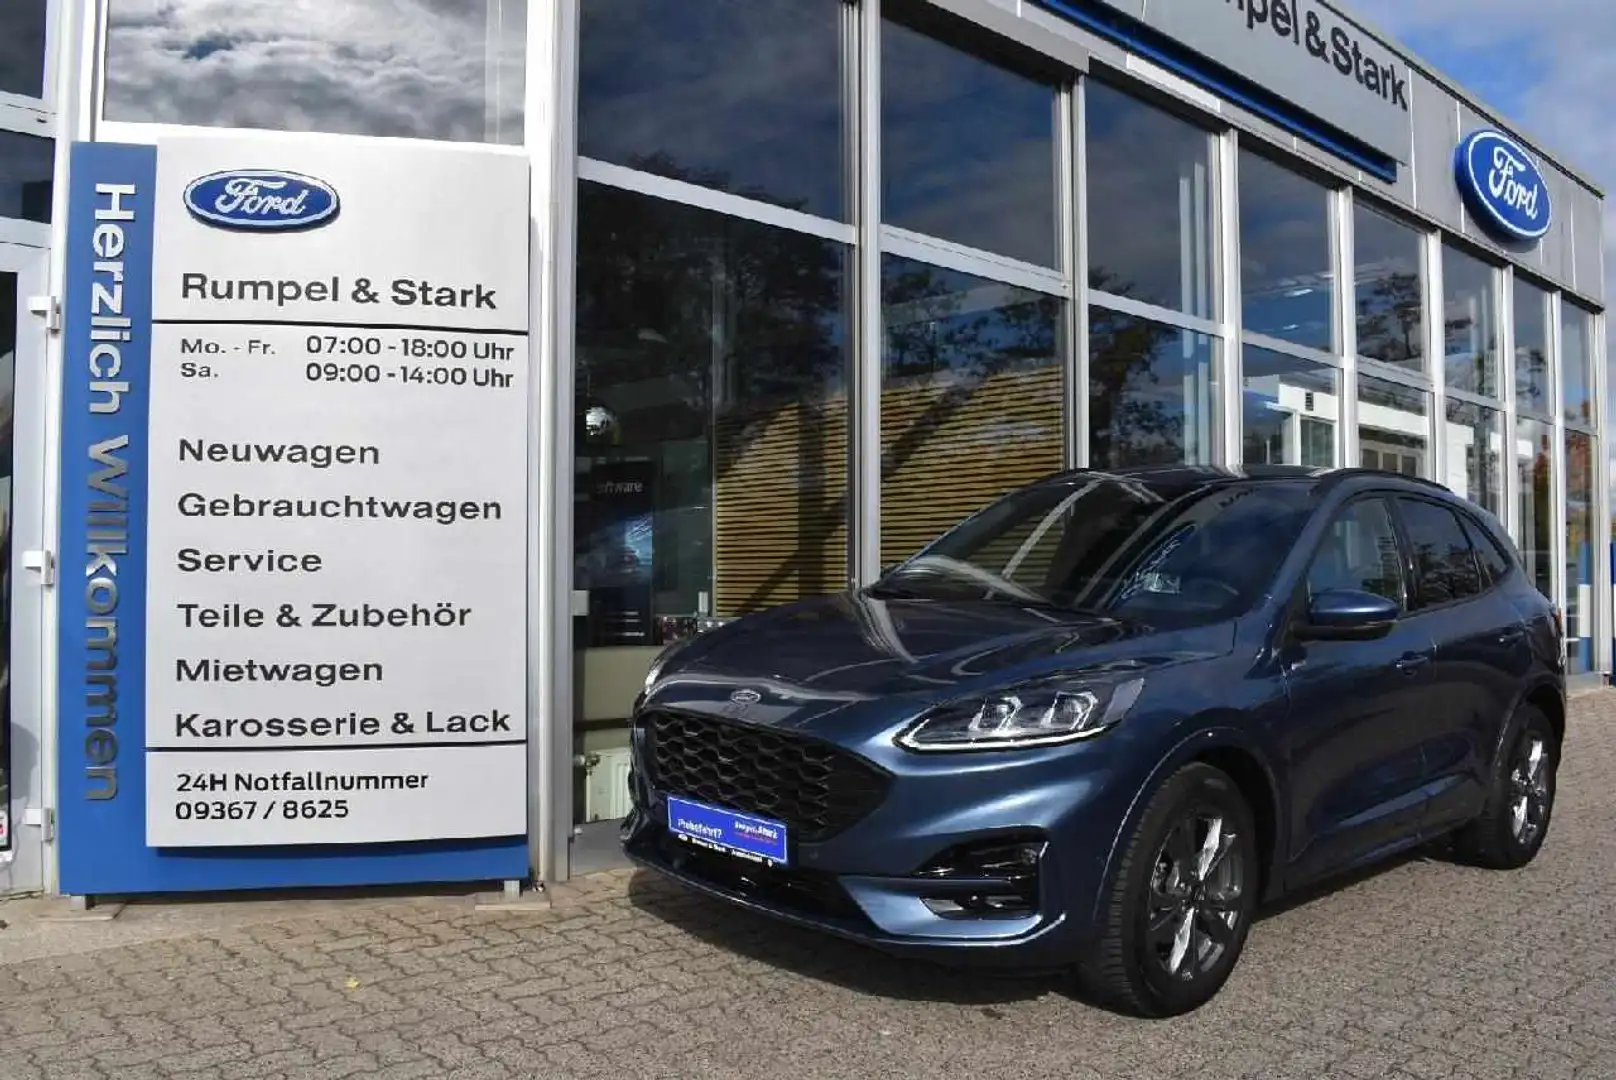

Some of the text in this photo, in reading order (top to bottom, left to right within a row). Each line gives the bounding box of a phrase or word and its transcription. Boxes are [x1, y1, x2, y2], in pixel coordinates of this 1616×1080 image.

[1226, 0, 1408, 111] pel & Stark
[215, 178, 309, 214] Ford
[1488, 145, 1538, 220] Ford
[182, 272, 497, 310] Rumpel & Stark
[181, 338, 227, 354] Mo.
[248, 339, 276, 355] Fr.
[306, 335, 381, 355] 07:00
[473, 340, 515, 361] Uhr
[181, 362, 219, 378] Sa.
[306, 362, 381, 383] 09:00
[473, 368, 514, 388] Uhr
[179, 438, 380, 469] Neuwagen
[85, 182, 136, 802] Herzlich Willkommen
[177, 492, 501, 525] Gebrauchtwagen
[177, 548, 322, 573] Service
[176, 602, 472, 628] Teile & Zubehör
[176, 659, 383, 687] Mietwagen
[175, 709, 511, 738] Karosserie & Lack
[176, 771, 429, 792] 24H Notfallnummer
[175, 799, 349, 820] 09367 / 8625
